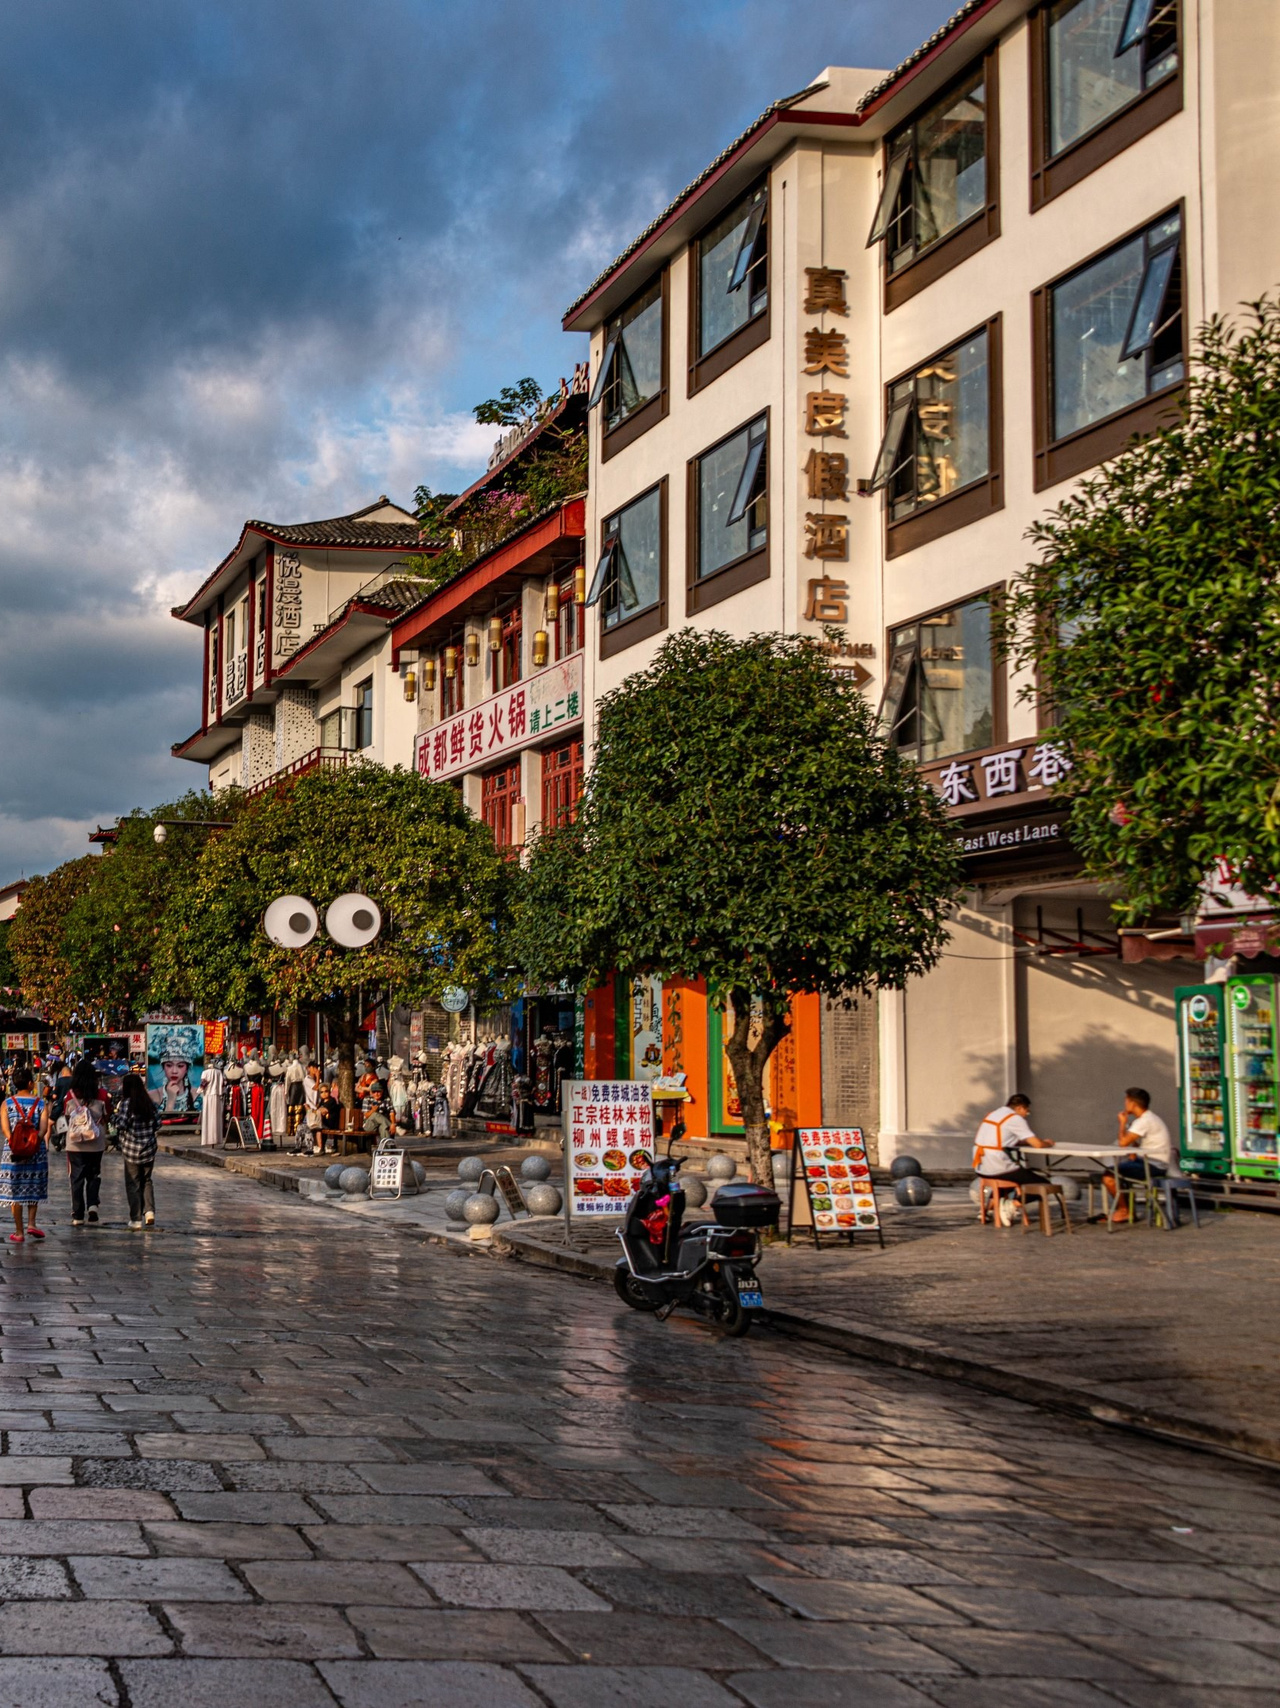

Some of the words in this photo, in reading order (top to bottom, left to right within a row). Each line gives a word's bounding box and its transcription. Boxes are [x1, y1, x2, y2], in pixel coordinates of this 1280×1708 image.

[802, 266, 848, 622] 真美度假酒店
[274, 551, 302, 657] 悦漫酒店
[418, 690, 526, 778] 成都鲜货火锅
[529, 690, 579, 734] 请上二楼
[939, 741, 1074, 806] 东西巷
[956, 835, 985, 851] East
[987, 829, 1022, 846] West
[1024, 823, 1059, 840] Lane
[572, 1104, 651, 1125] 正宗桂林米粉
[572, 1127, 652, 1148] 柳州螺蛳粉
[800, 1130, 862, 1146] 免费恭城油茶
